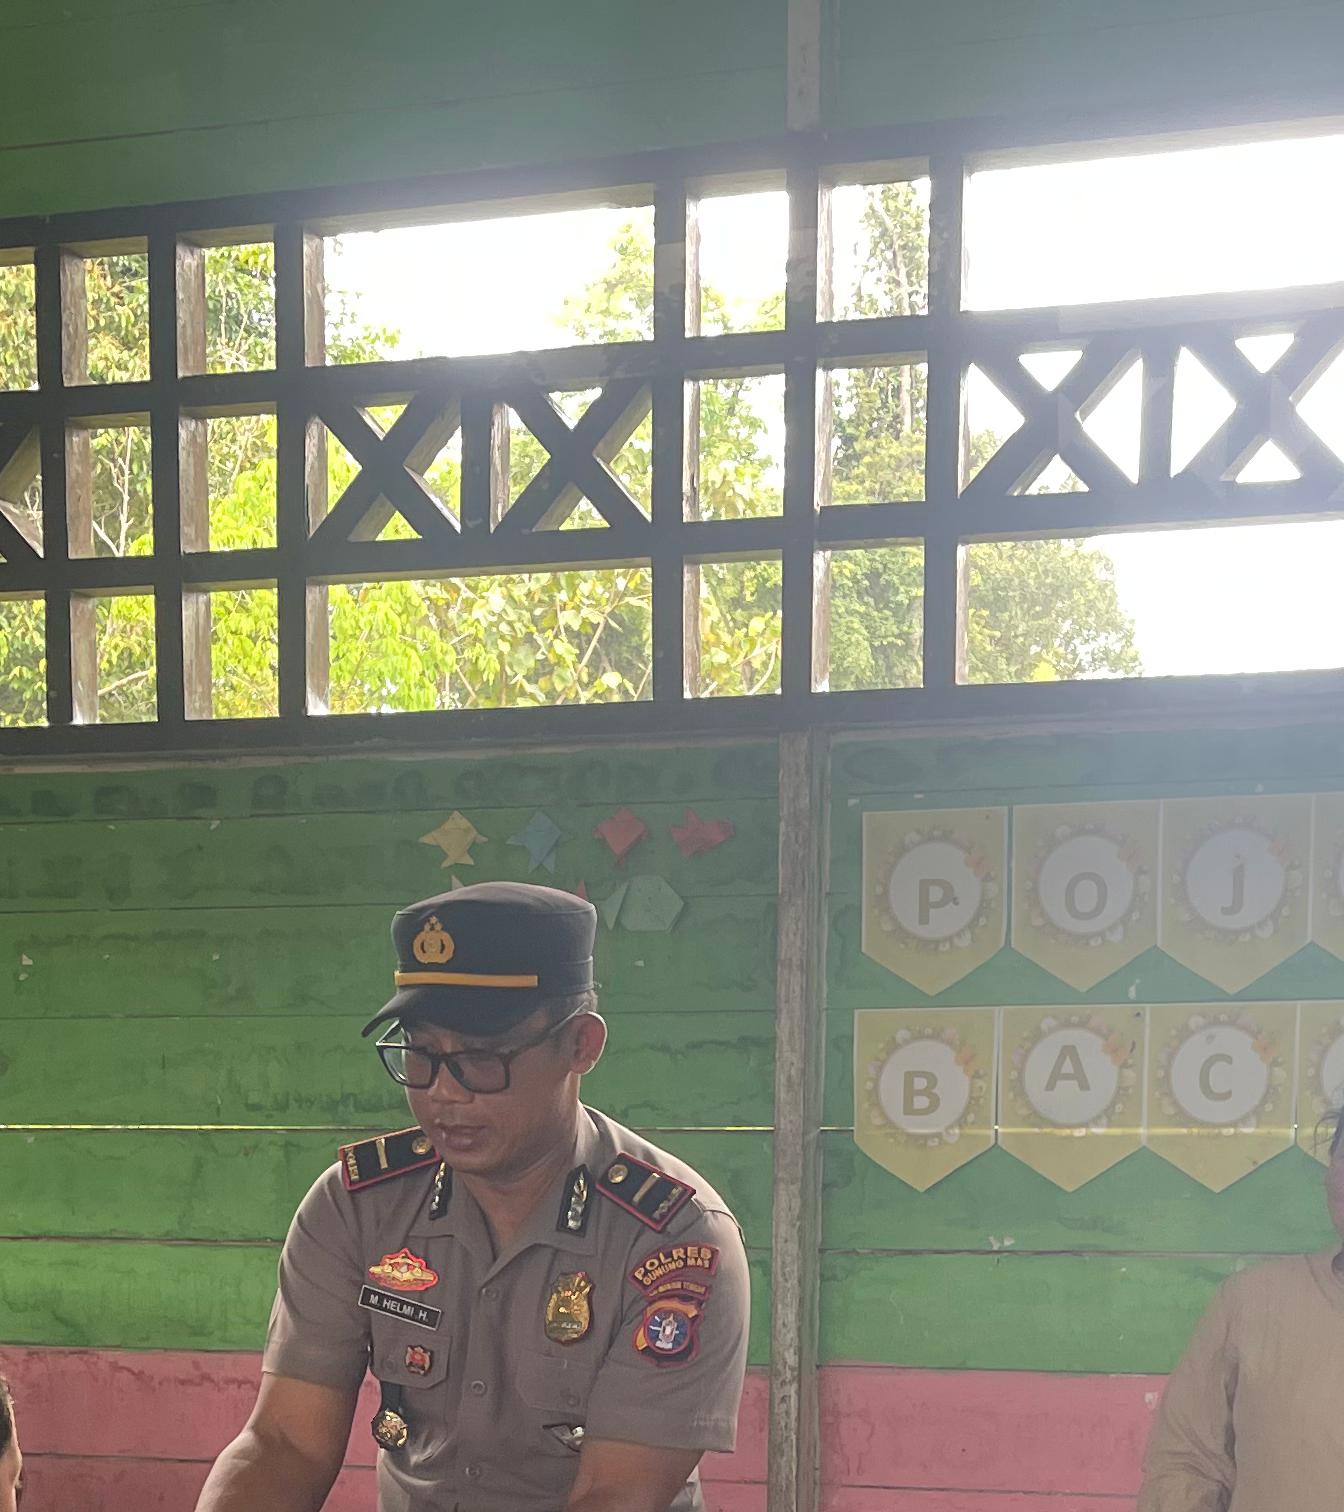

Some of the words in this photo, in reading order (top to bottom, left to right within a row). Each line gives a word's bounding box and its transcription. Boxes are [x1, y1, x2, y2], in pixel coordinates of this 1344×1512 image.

[634, 1246, 712, 1281] POLRES
[687, 1258, 710, 1268] MAS
[369, 1294, 381, 1306] M.
[382, 1299, 414, 1317] HELMI
